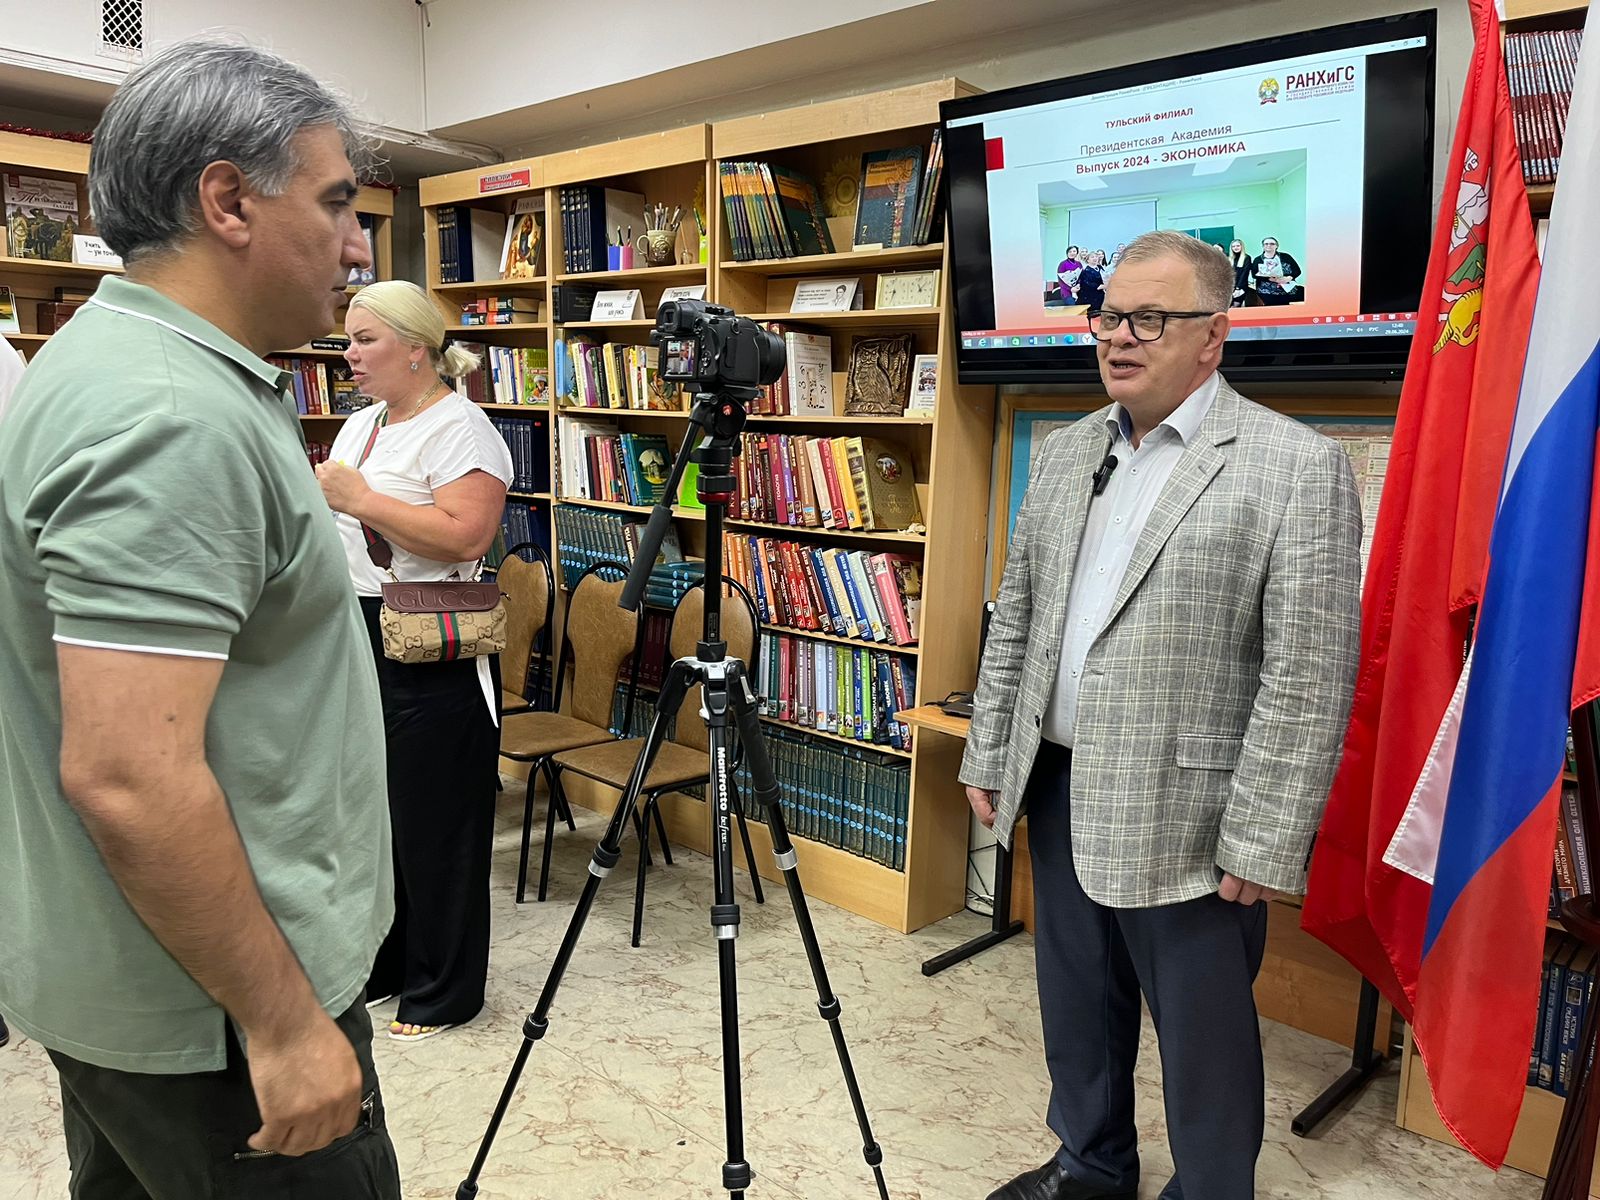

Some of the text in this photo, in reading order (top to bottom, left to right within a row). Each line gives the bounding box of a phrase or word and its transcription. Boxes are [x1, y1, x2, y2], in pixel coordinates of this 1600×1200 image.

[1286, 65, 1355, 90] РАНХиГС
[1105, 107, 1194, 129] ТУЛЬСКИЙ ФИЛИАЛ
[1080, 124, 1232, 156] Президентская Академия
[1076, 159, 1120, 174] Выпуск
[1123, 154, 1150, 168] 2024
[1161, 141, 1246, 163] ЭКОНОМИКА
[394, 589, 490, 608] GUCCI
[717, 746, 728, 811] Manfrotto
[719, 815, 730, 843] befree
[1568, 794, 1591, 894] ЭНЦИКЛОПЕДИЯ ДЛЯ ДЕТЕЙ
[1554, 849, 1562, 875] ИСТОРИЯ
[1558, 840, 1571, 884] ДРЕВНЕГО МИРА
